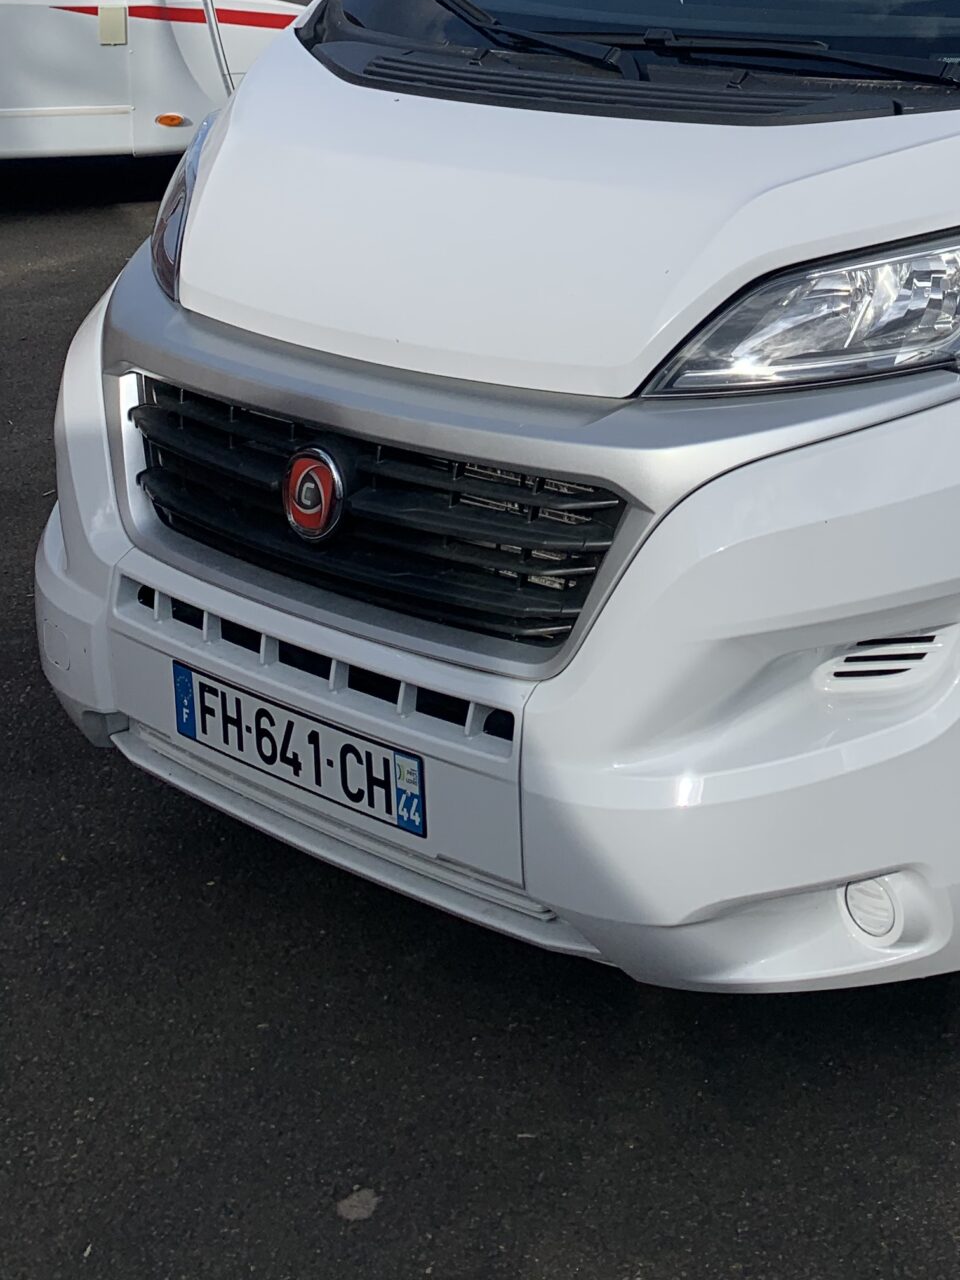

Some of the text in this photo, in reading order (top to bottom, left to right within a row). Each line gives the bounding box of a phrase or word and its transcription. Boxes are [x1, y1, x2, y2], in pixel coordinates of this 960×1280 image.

[183, 709, 190, 722] F
[199, 681, 392, 815] FH-641-CH
[398, 793, 421, 826] 44
